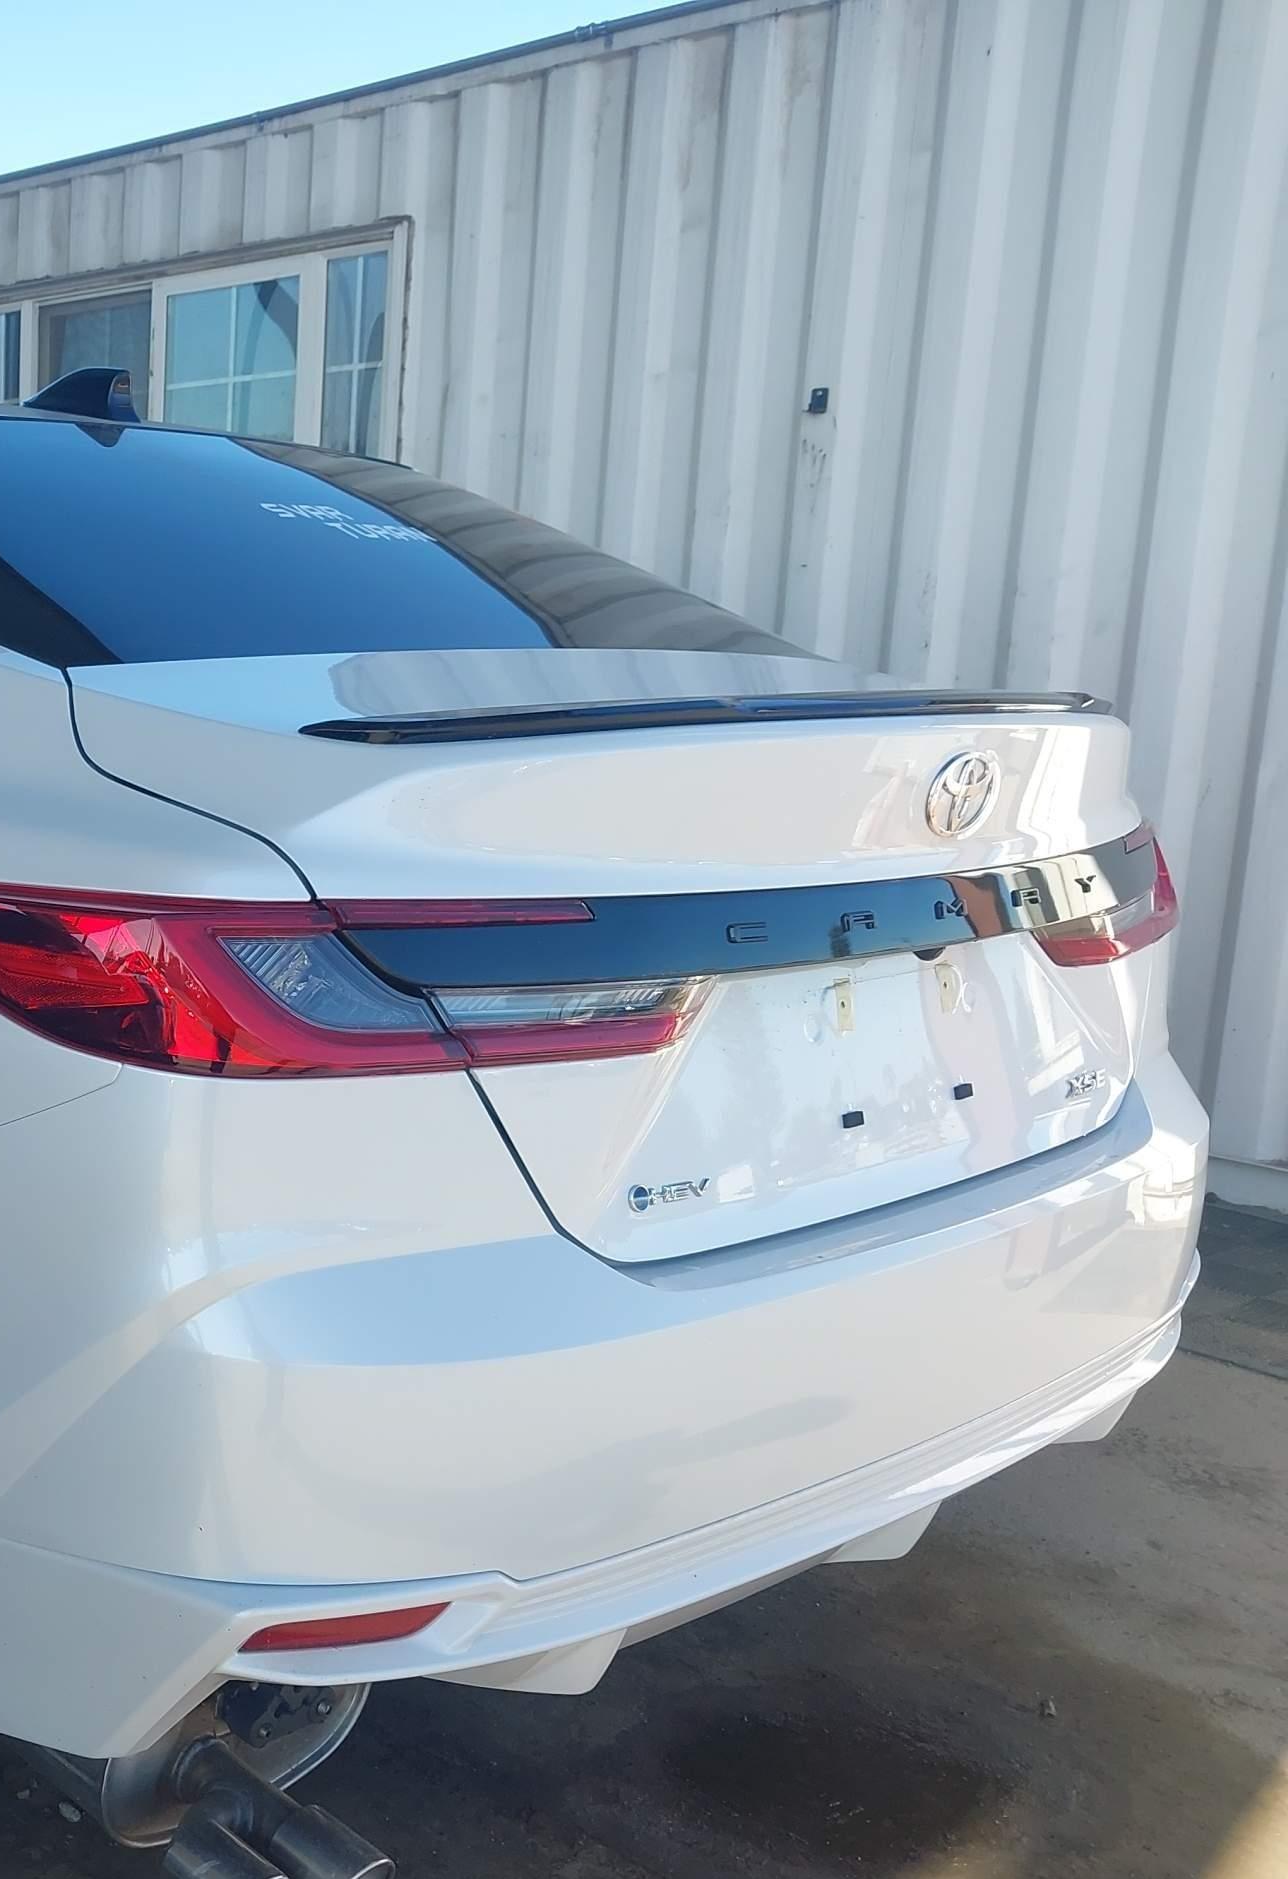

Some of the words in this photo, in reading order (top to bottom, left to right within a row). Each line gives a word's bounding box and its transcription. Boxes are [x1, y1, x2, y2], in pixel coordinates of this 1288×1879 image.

[260, 503, 354, 521] SVAR
[725, 874, 1097, 944] CAMRY
[1065, 1068, 1106, 1098] XSE
[648, 1177, 710, 1206] HEV
